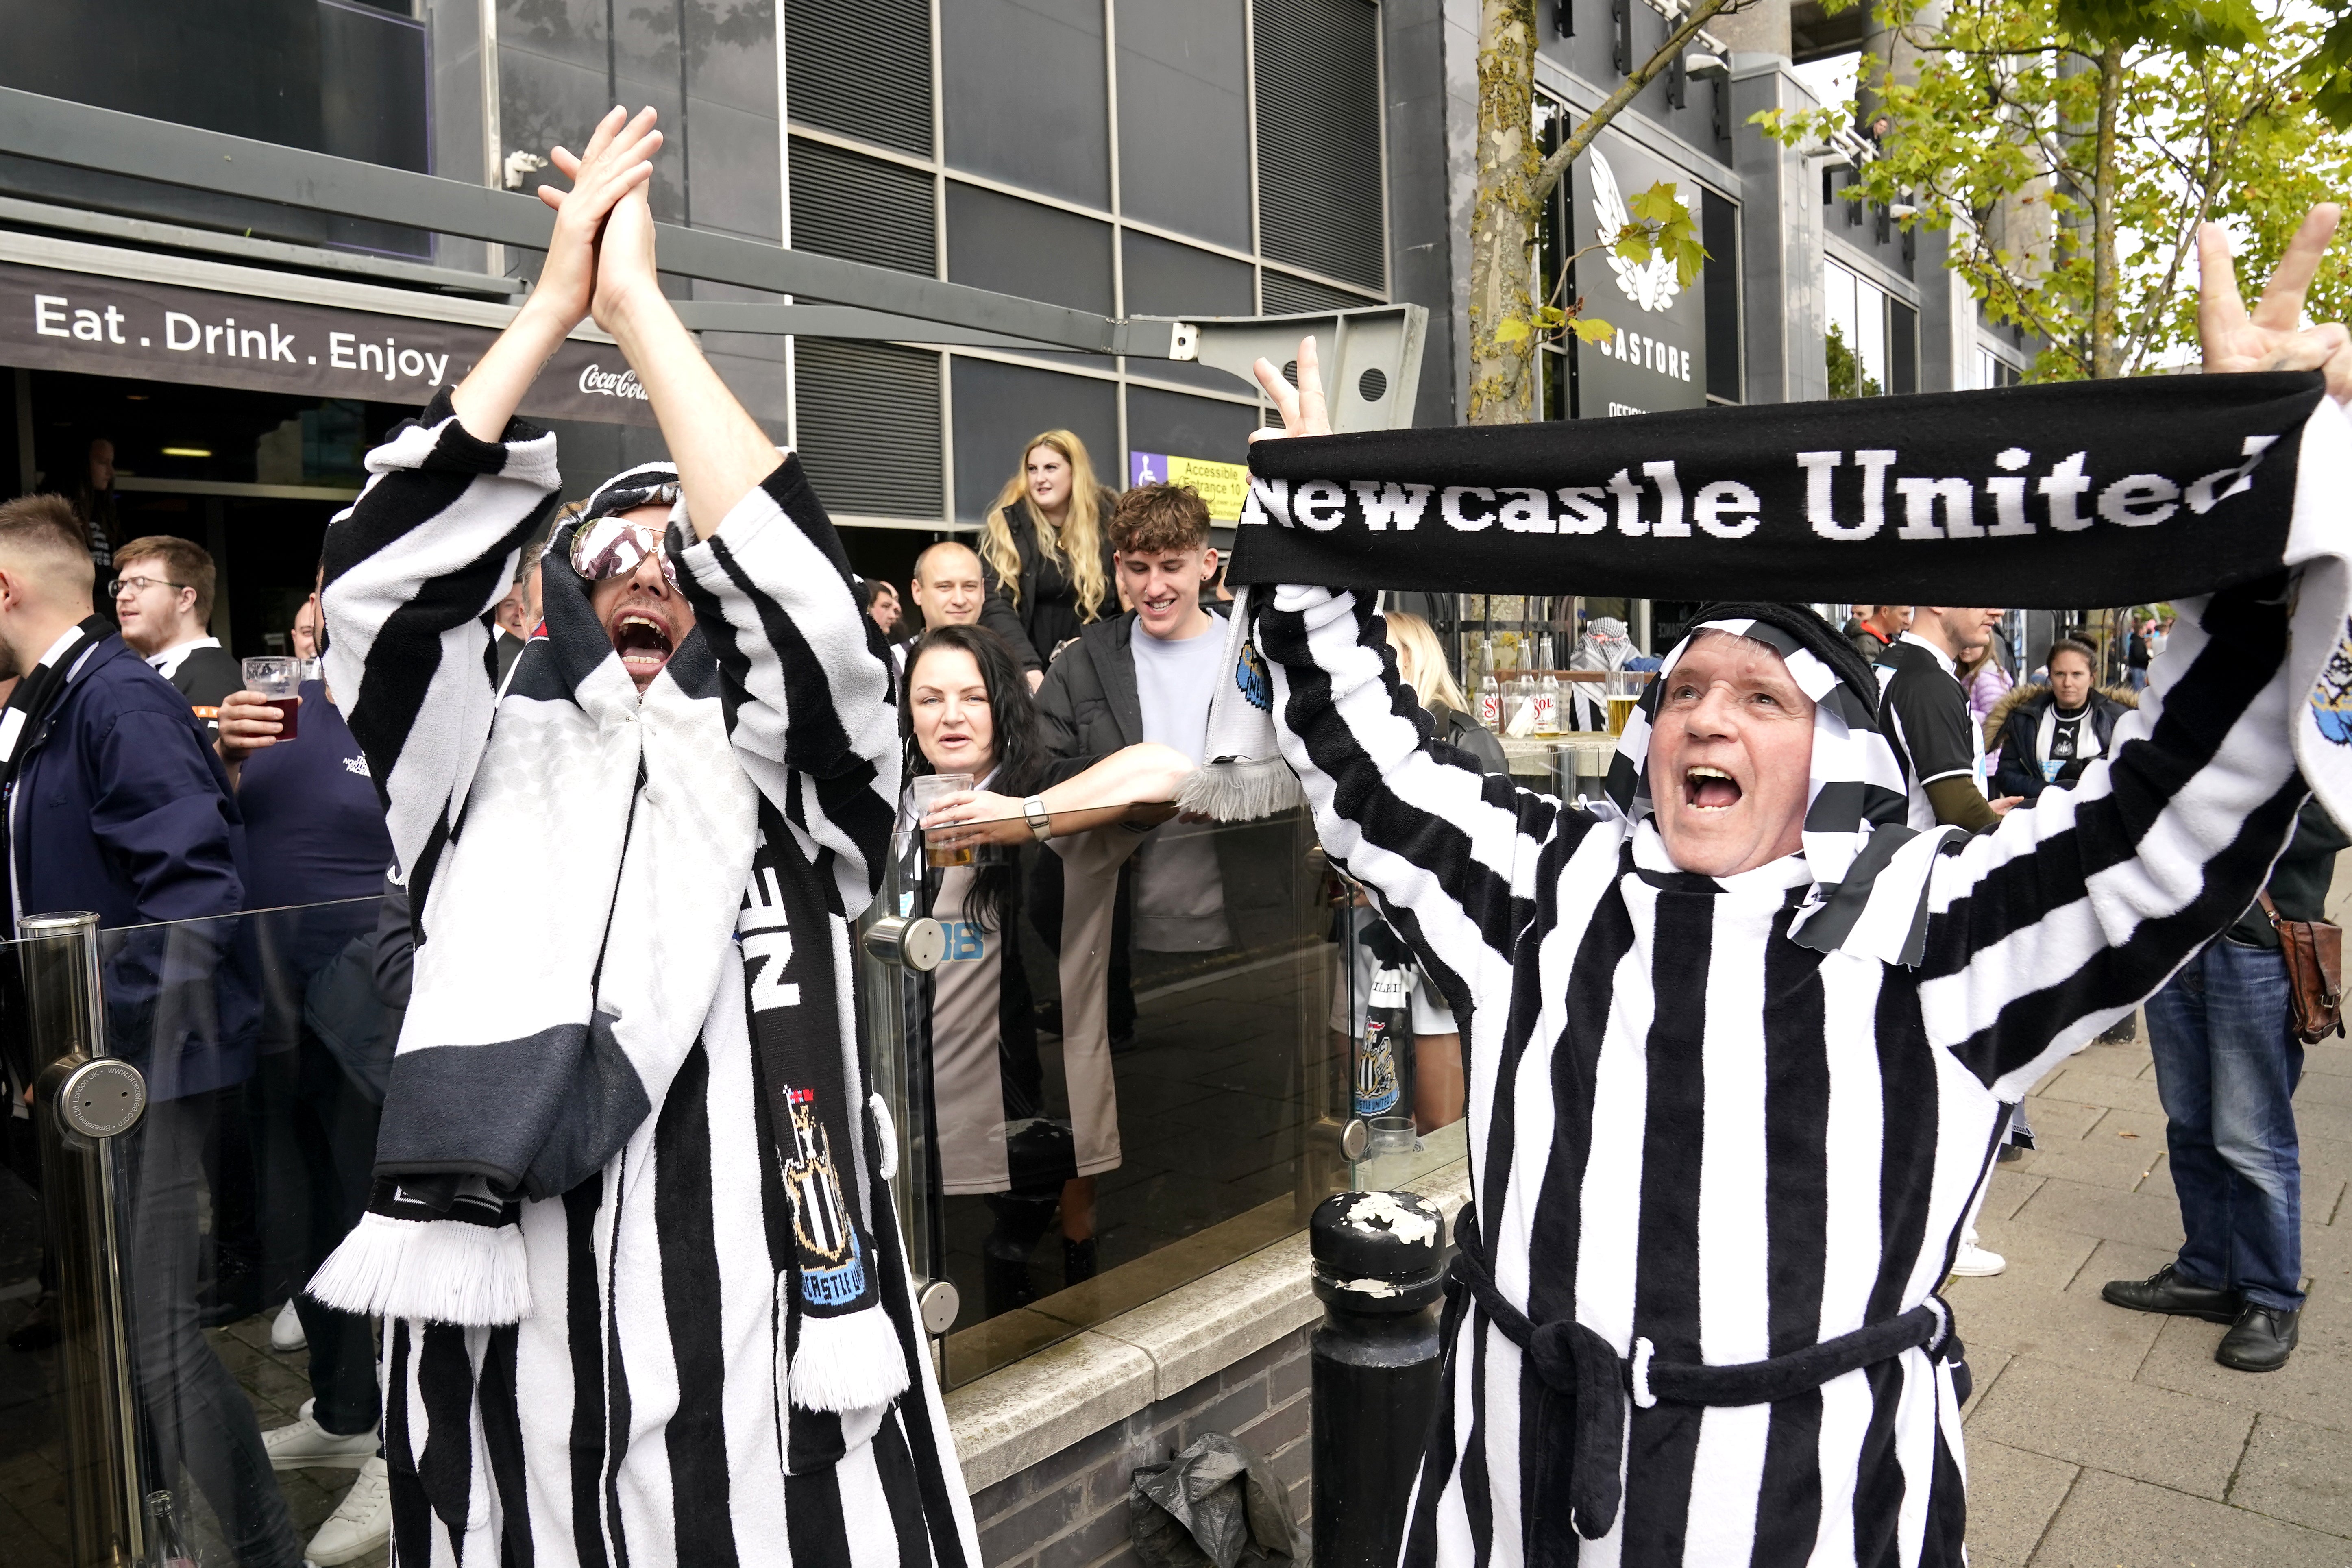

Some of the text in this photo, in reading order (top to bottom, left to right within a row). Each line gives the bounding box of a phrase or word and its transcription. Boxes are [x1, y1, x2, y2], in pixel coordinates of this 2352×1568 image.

[34, 294, 126, 344] Eat
[165, 311, 297, 364] Drink
[330, 331, 449, 386] Enjoy
[1185, 462, 1238, 480] Accessible
[1231, 483, 1241, 496] 10
[1241, 436, 2279, 541] Newcastle United
[72, 1079, 89, 1103] London
[87, 1070, 100, 1080] UK
